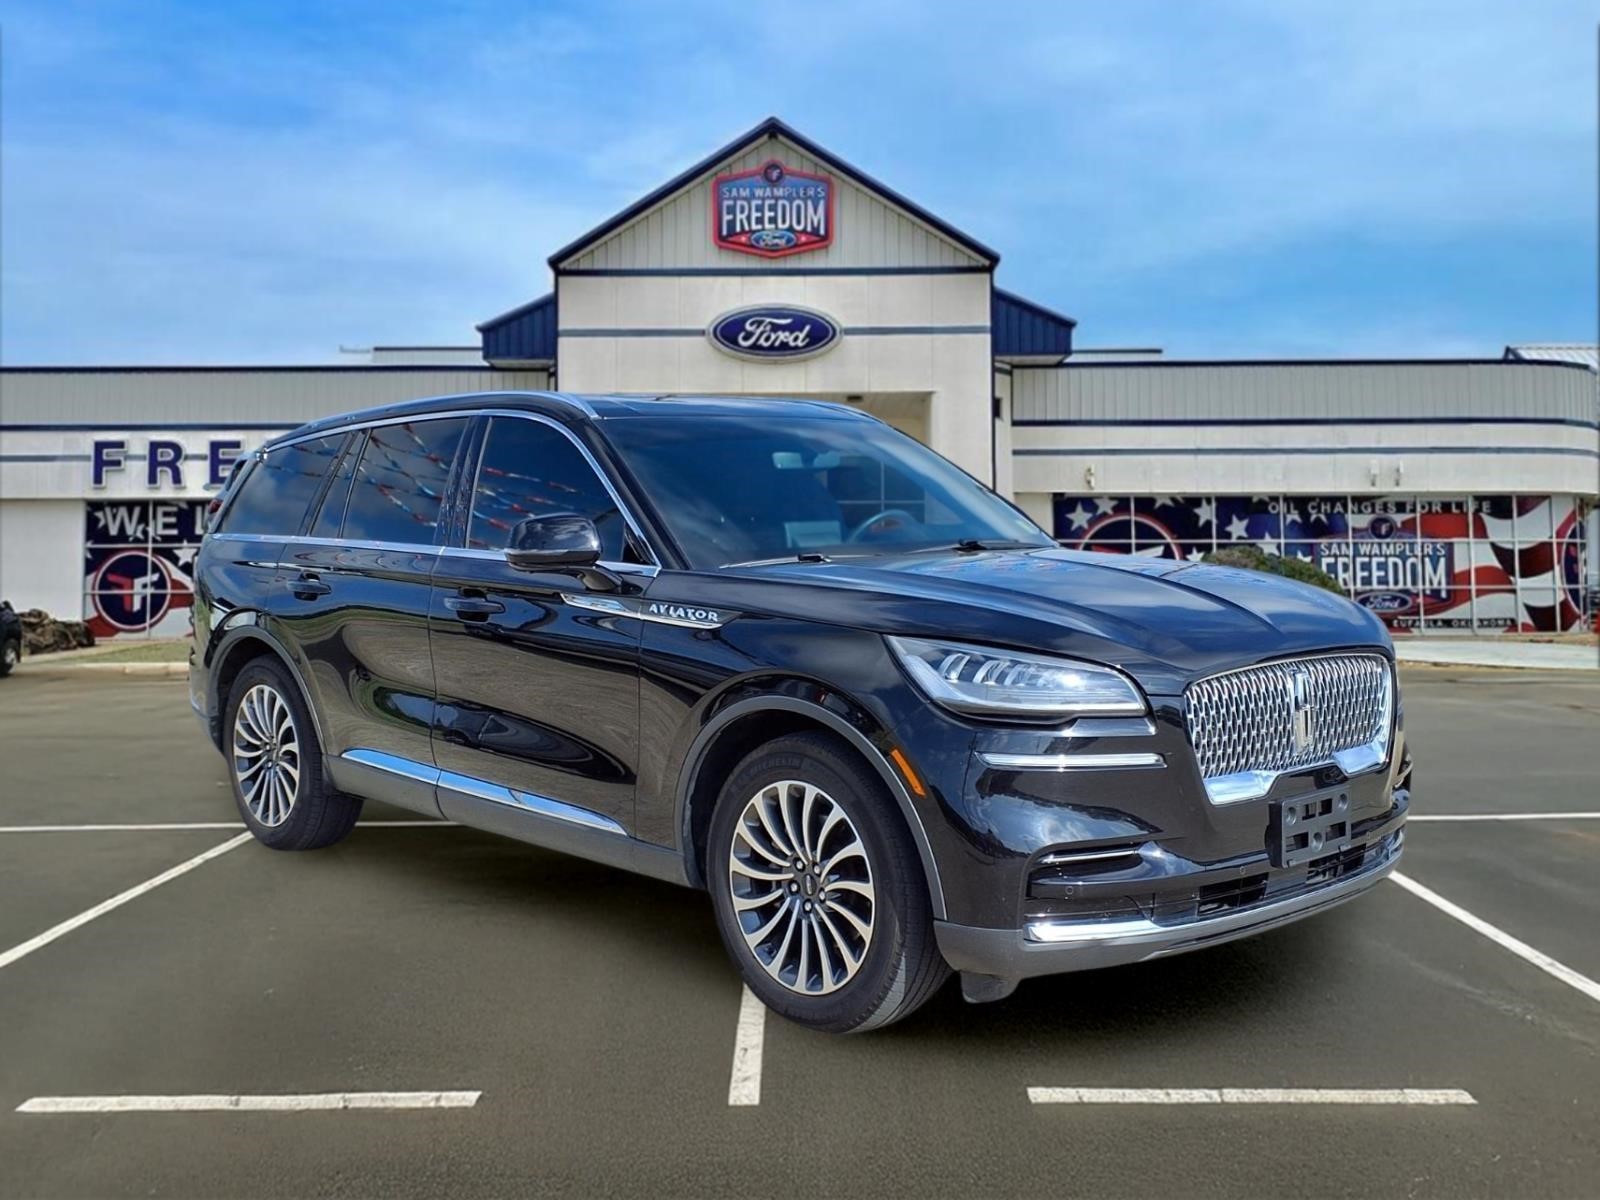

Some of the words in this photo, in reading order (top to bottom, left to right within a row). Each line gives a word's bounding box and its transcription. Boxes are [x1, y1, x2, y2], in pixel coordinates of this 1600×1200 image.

[722, 187, 750, 198] SAM
[722, 200, 825, 236] FREEDOM
[759, 232, 788, 246] Ford
[738, 317, 811, 347] Ford
[1268, 501, 1299, 514] OIL
[1308, 501, 1397, 514] CHANGES
[1405, 501, 1442, 514] FOR
[1451, 501, 1491, 514] LIFE
[1321, 557, 1448, 599] FREEDOM
[1365, 595, 1400, 609] Ford
[649, 603, 719, 622] AVIATOR
